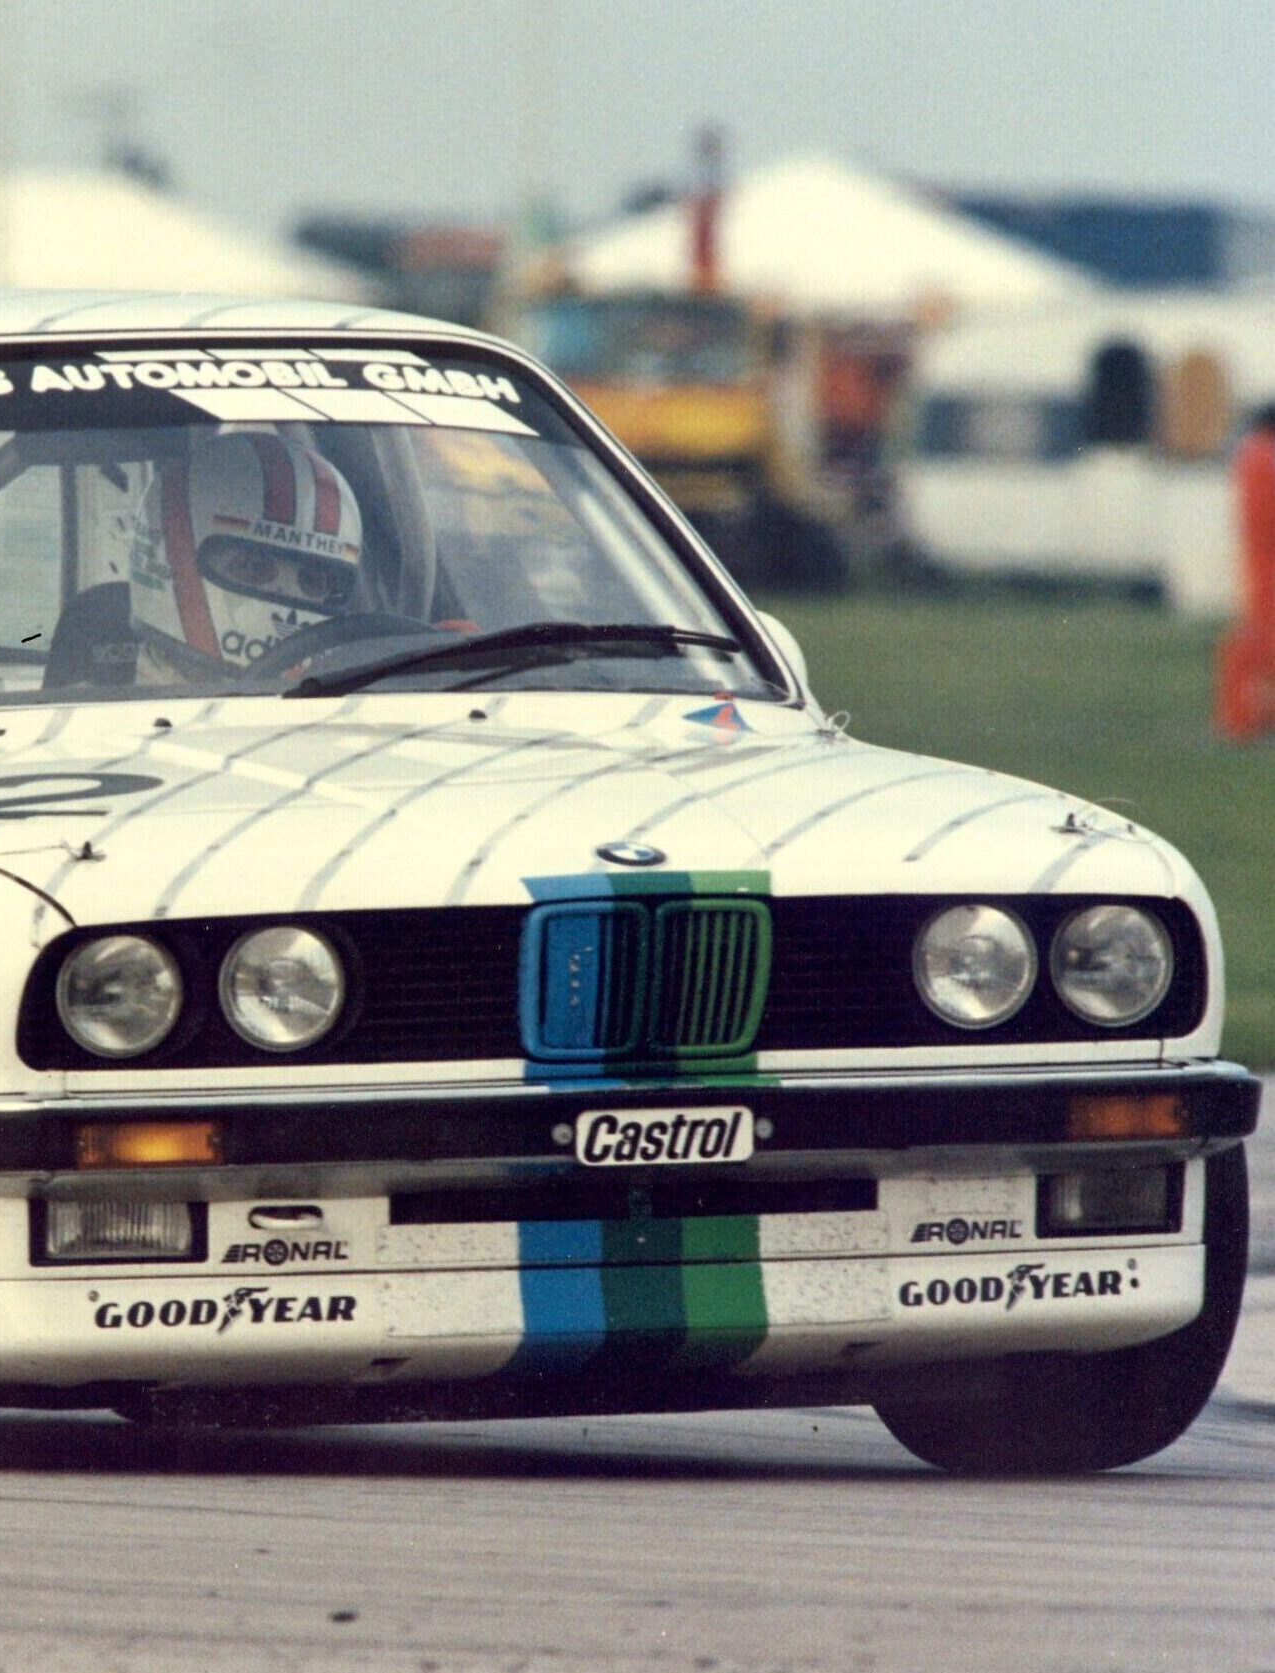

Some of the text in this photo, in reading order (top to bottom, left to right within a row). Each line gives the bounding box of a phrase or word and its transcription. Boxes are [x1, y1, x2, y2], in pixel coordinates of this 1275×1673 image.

[29, 359, 346, 396] AUTOMOBIL
[361, 361, 521, 404] GMBH
[584, 1111, 743, 1163] Castrol
